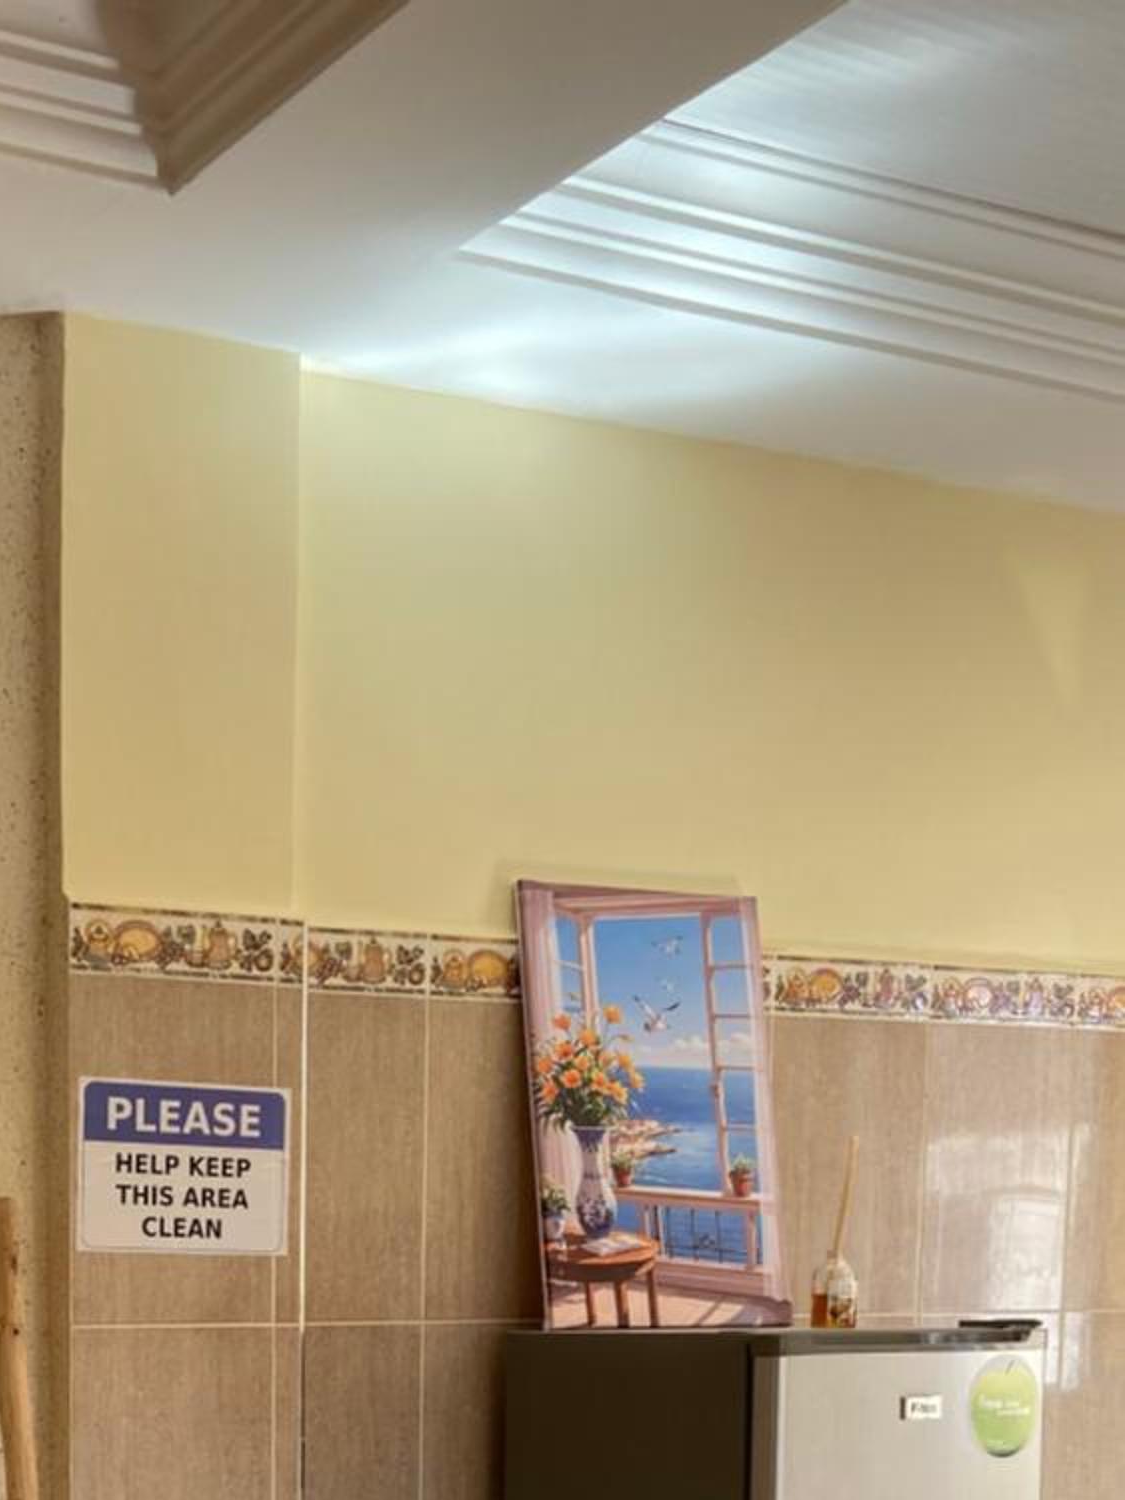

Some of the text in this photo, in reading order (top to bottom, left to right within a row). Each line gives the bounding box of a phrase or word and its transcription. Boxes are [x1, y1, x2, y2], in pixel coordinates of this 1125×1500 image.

[106, 1096, 262, 1138] PLEASE
[115, 1152, 252, 1179] HELP KEEP
[115, 1184, 249, 1209] THIS AREA
[141, 1216, 223, 1239] CLEAN
